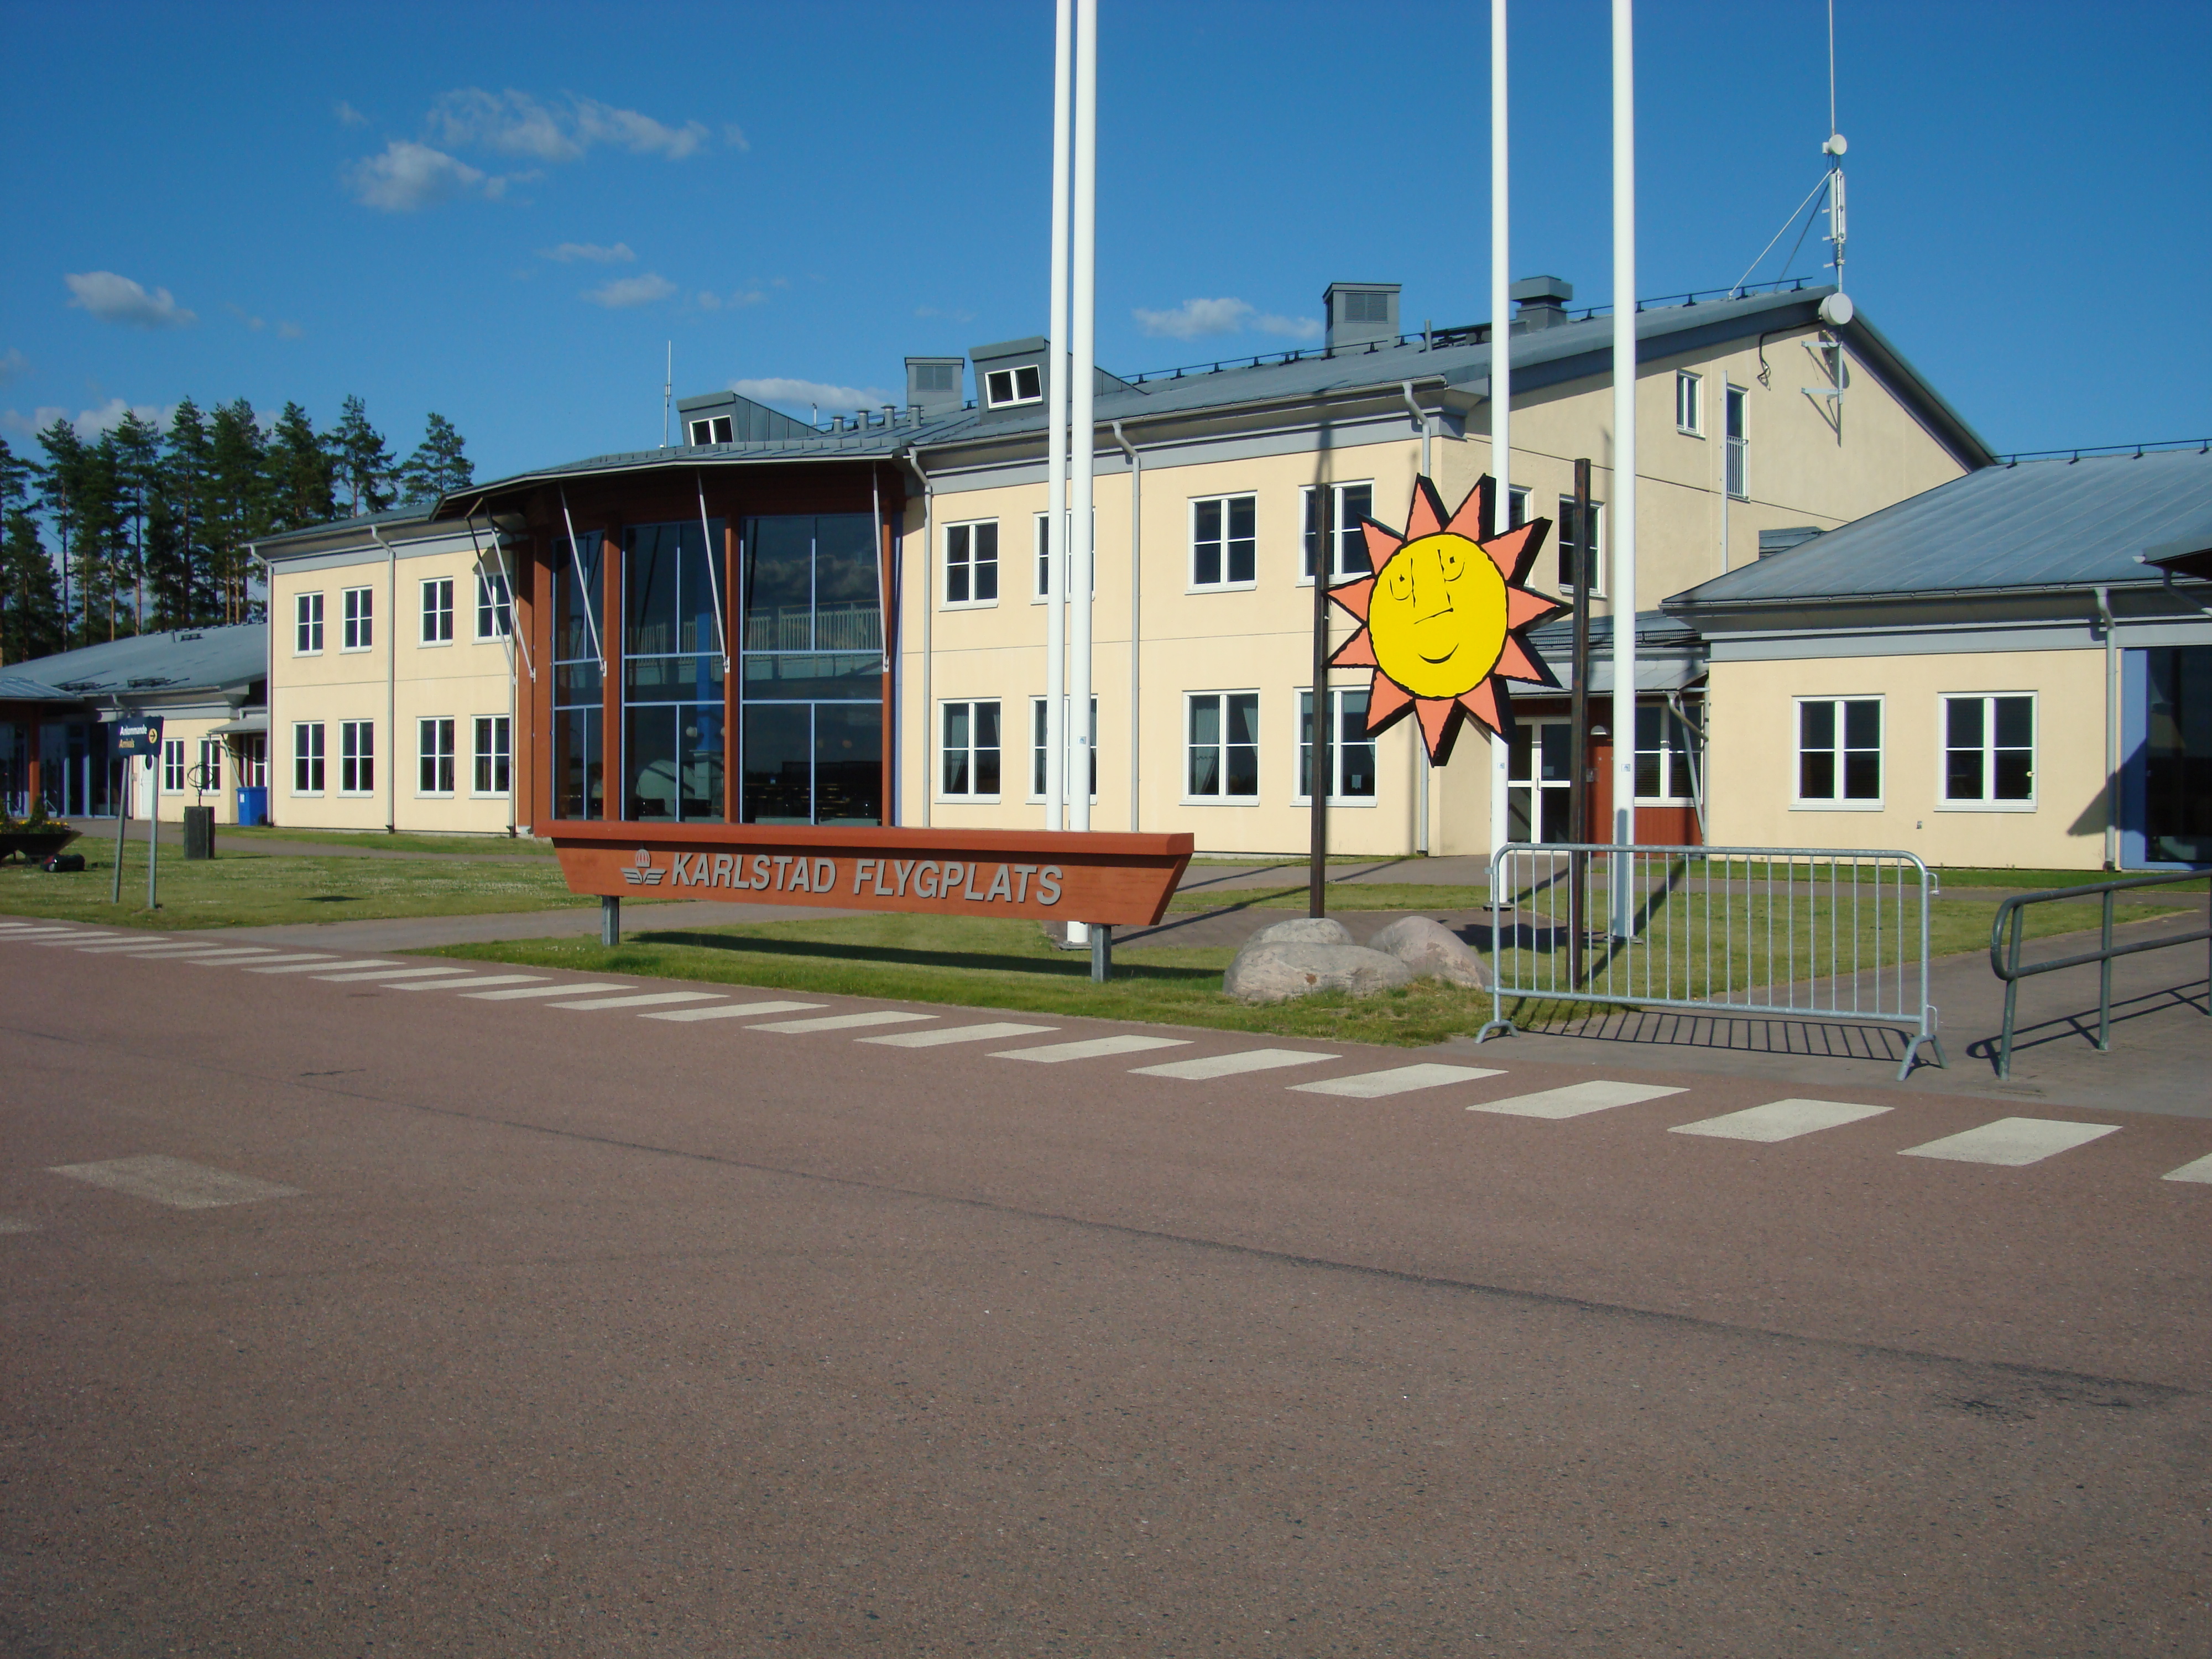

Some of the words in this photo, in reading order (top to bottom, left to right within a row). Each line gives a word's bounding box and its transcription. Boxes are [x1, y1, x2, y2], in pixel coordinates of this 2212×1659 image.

[119, 724, 148, 735] Ankommande
[119, 738, 135, 748] Arrivals
[671, 852, 836, 893] KARLSTAD
[853, 858, 1063, 906] FLYGPLATS
